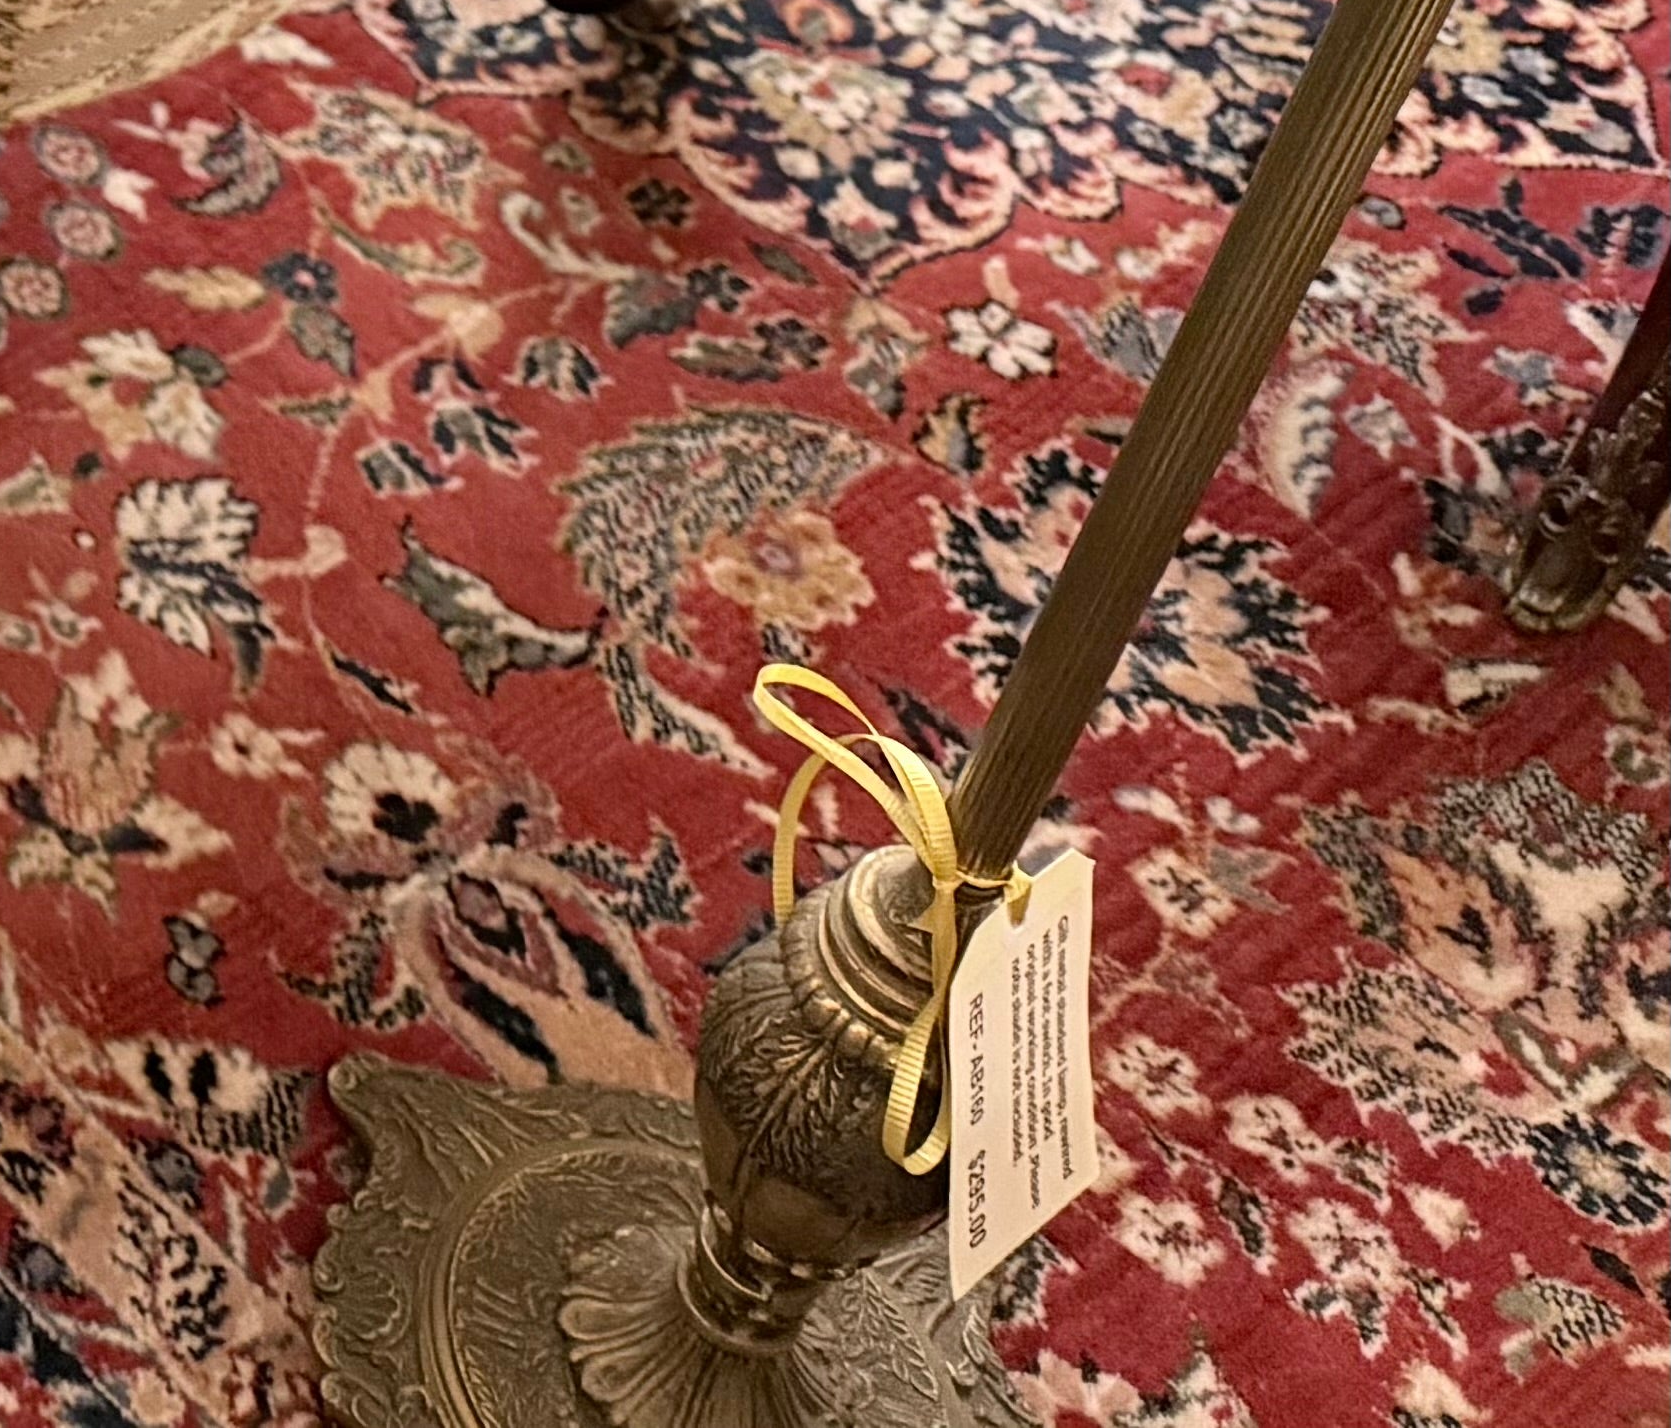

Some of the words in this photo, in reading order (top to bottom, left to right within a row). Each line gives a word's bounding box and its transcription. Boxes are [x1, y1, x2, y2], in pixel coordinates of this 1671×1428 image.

[1012, 958, 1021, 996] note
[1025, 944, 1037, 1006] original
[1043, 928, 1053, 967] with
[1012, 997, 1023, 1046] shade
[1025, 1006, 1038, 1075] working
[1058, 997, 1067, 1066] standard
[1013, 1066, 1022, 1095] not
[1028, 1076, 1038, 1149] condition
[1041, 1101, 1055, 1141] good
[1060, 1118, 1074, 1179] rewired
[968, 1149, 987, 1249] $295.00
